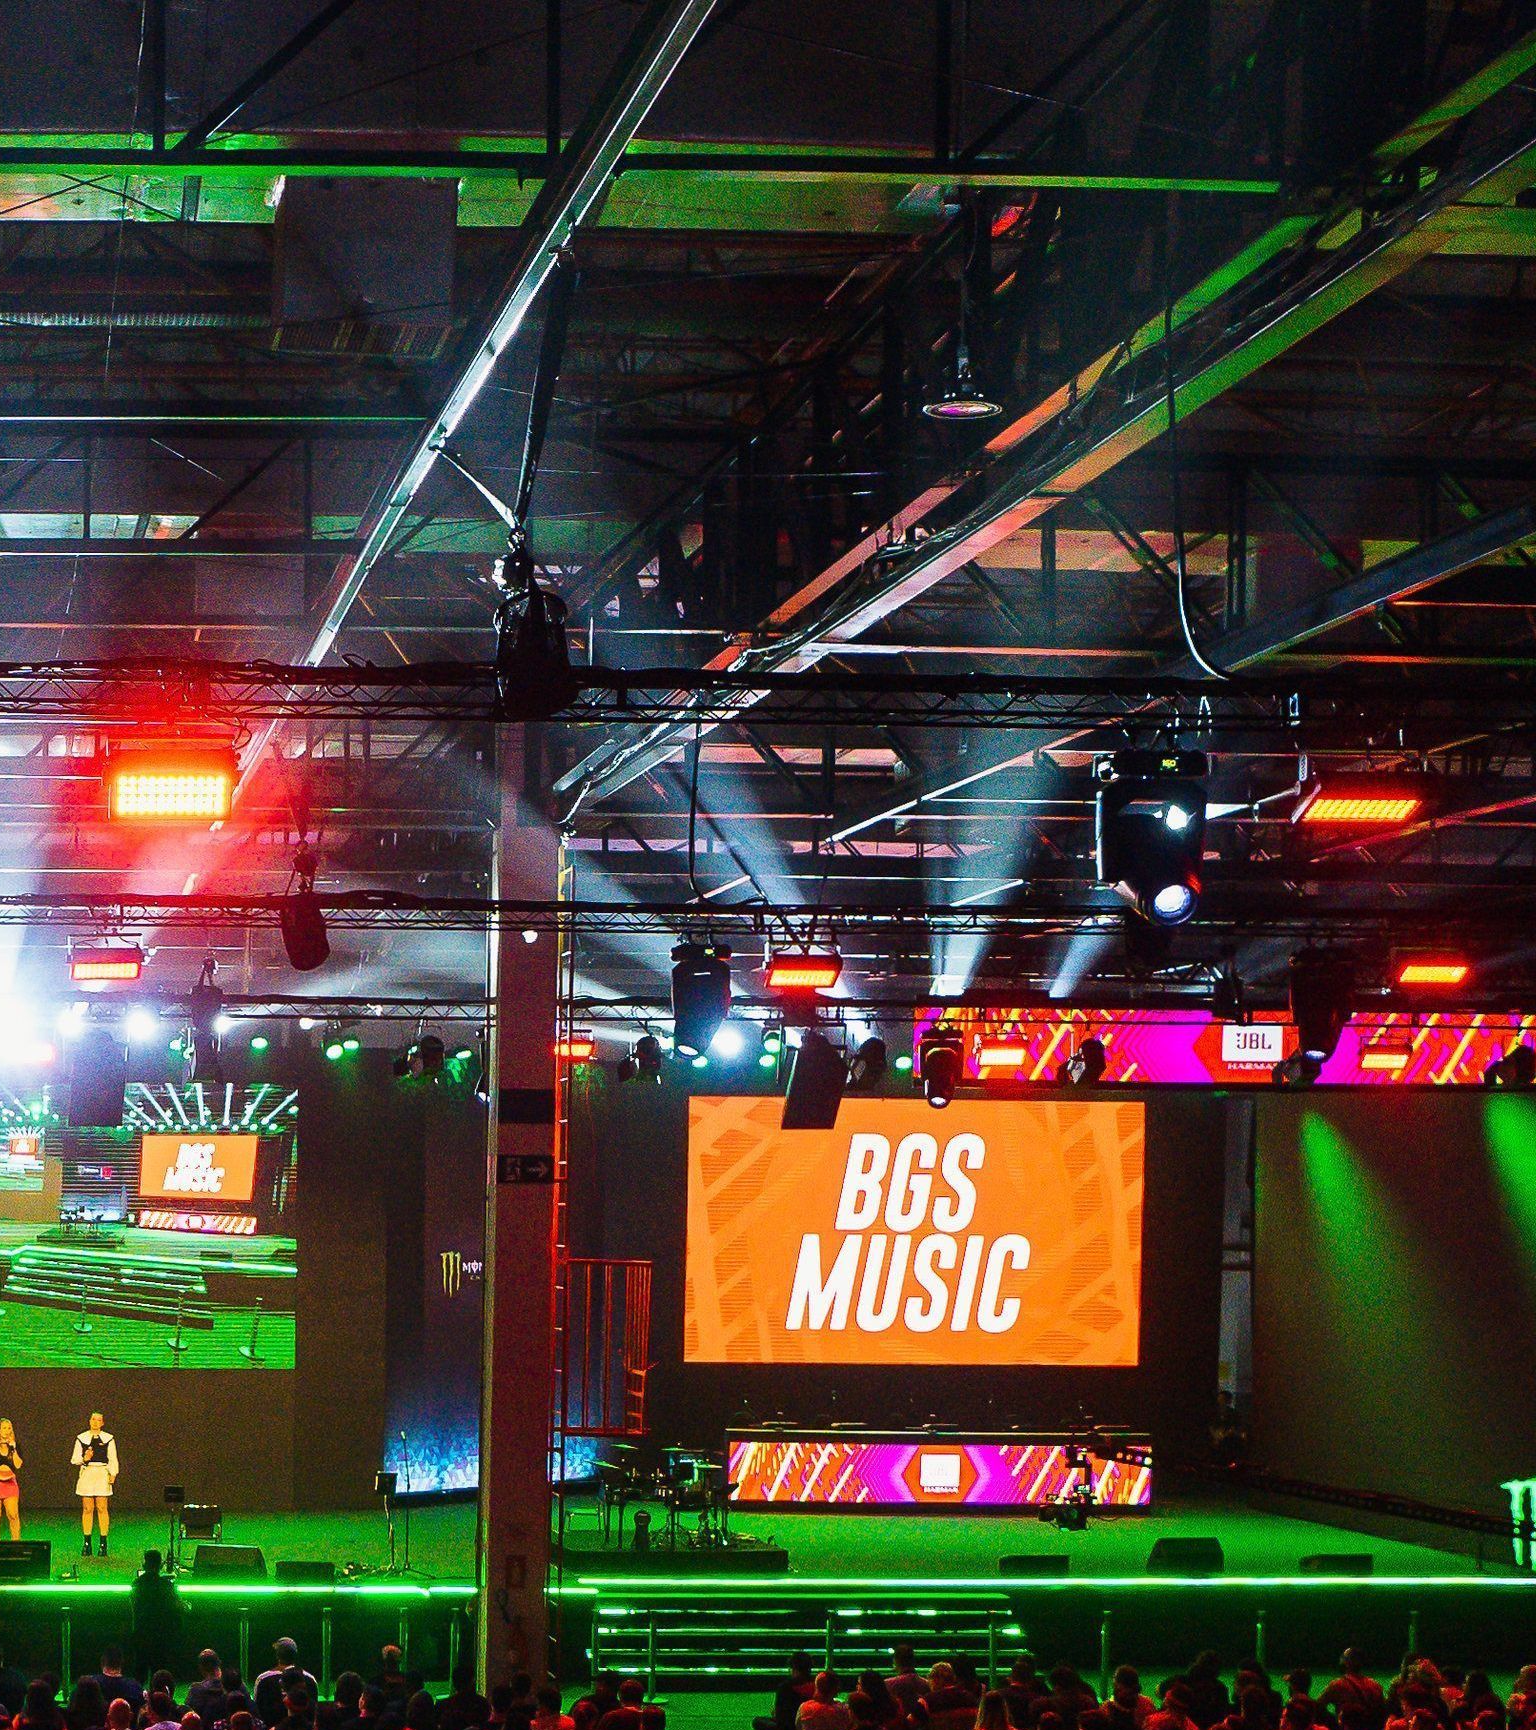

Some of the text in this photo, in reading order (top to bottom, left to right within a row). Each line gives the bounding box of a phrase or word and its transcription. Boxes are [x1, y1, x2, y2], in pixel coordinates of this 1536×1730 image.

[1236, 1032, 1272, 1050] JBL
[835, 1133, 986, 1231] BGS
[785, 1233, 1031, 1334] MUSIC
